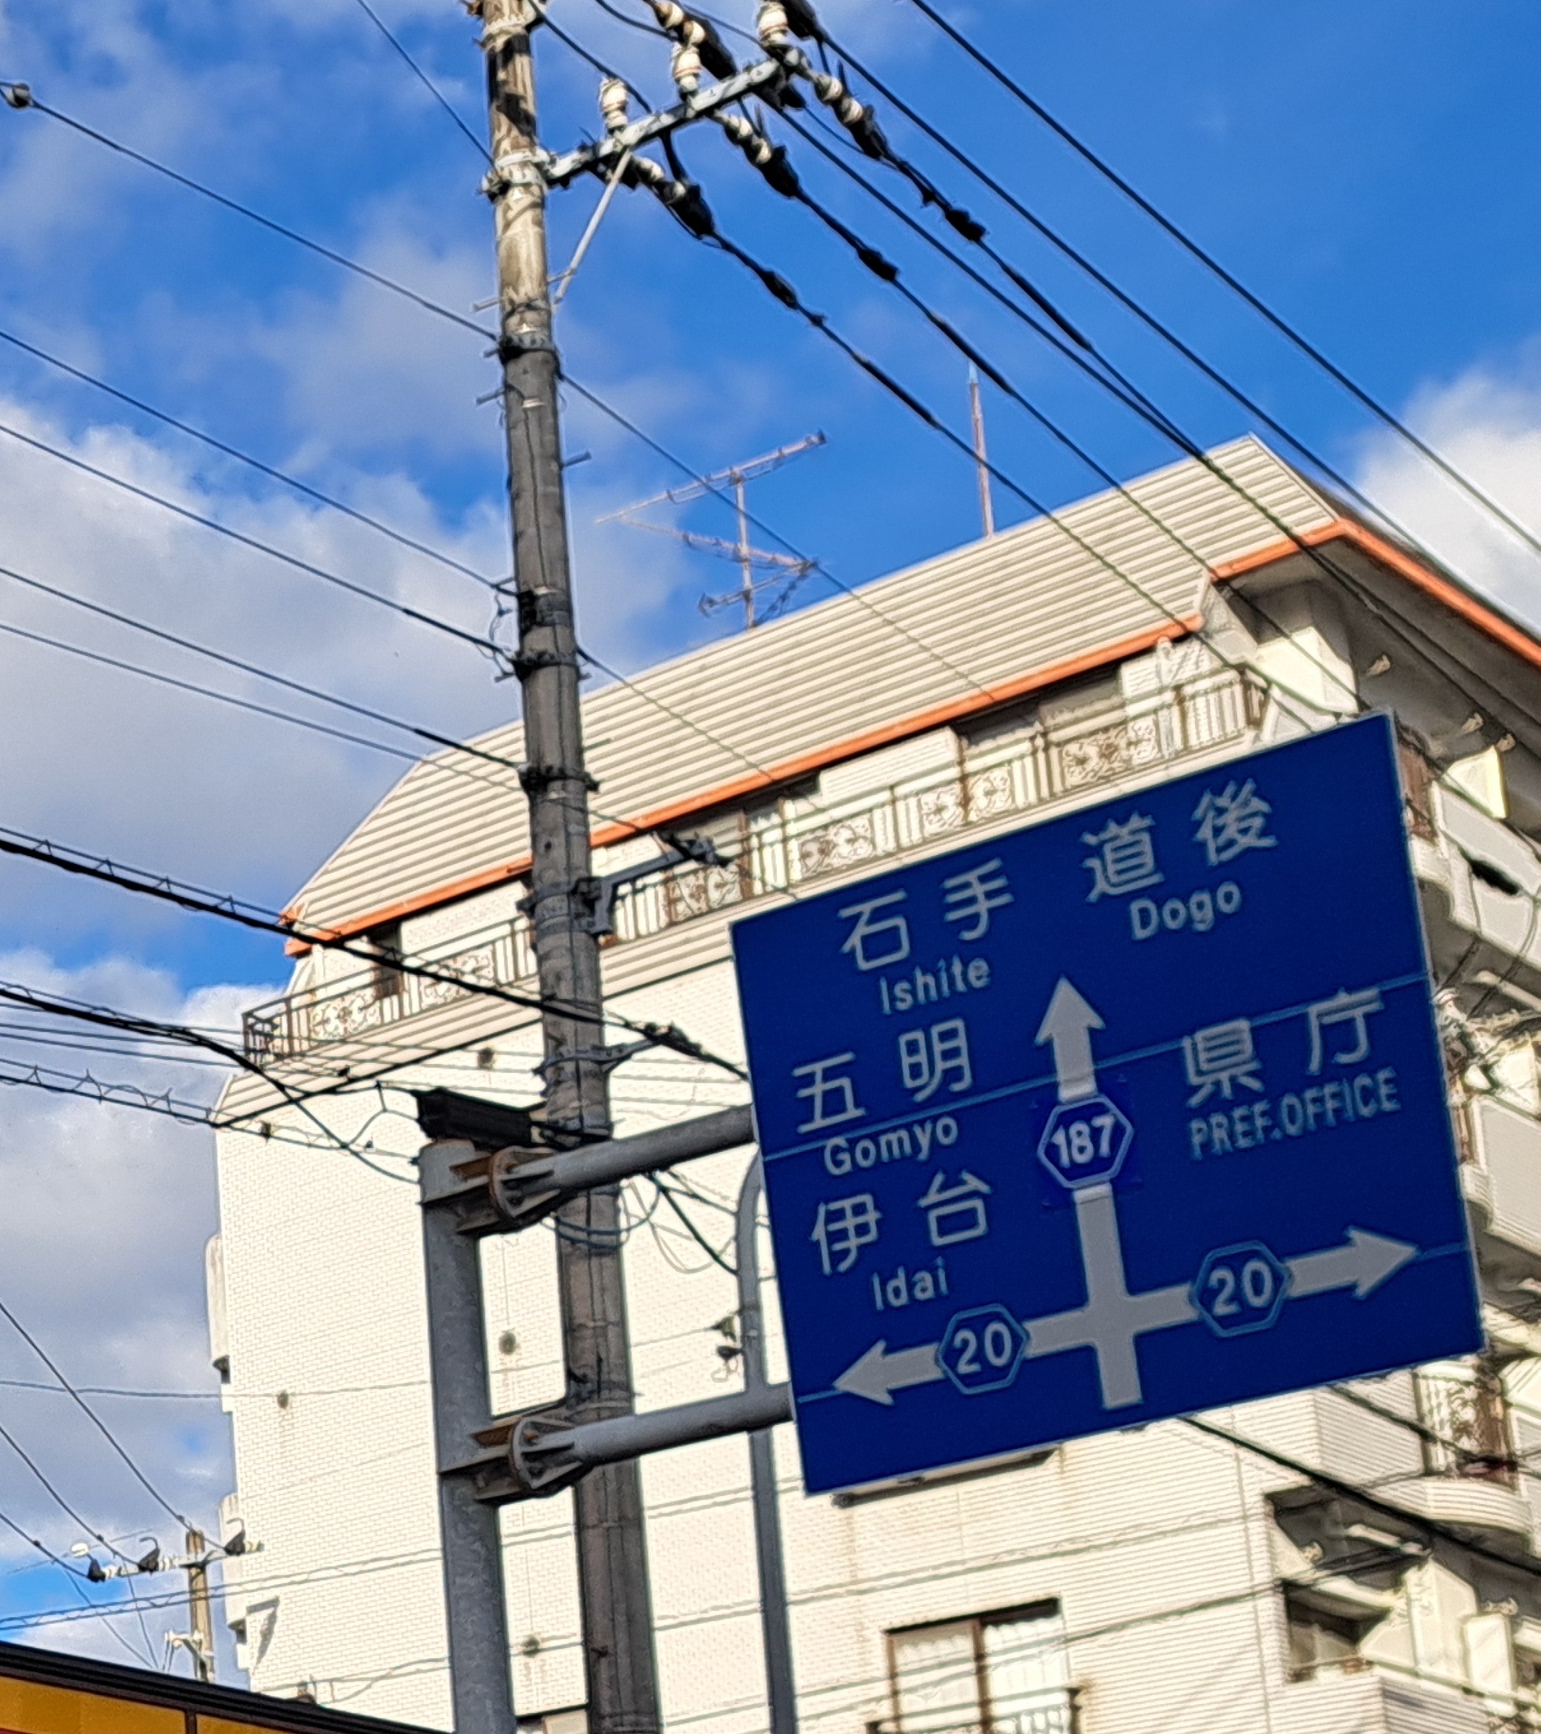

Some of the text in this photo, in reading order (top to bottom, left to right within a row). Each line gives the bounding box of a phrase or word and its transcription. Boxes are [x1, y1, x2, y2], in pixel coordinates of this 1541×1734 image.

[1079, 777, 1279, 903] 道後
[838, 858, 1015, 974] 石手
[1129, 879, 1243, 941] Dogo
[880, 955, 992, 1015] Ishite
[792, 1017, 976, 1135] 五明
[1180, 987, 1386, 1109] 県庁
[822, 1114, 960, 1176] Gomyo
[1050, 1114, 1116, 1168] 187
[1188, 1066, 1402, 1162] PREF.OFFICE
[810, 1170, 992, 1276] 伊台
[872, 1256, 949, 1311] Idai
[1206, 1260, 1274, 1316] 20
[952, 1322, 1014, 1371] 20
